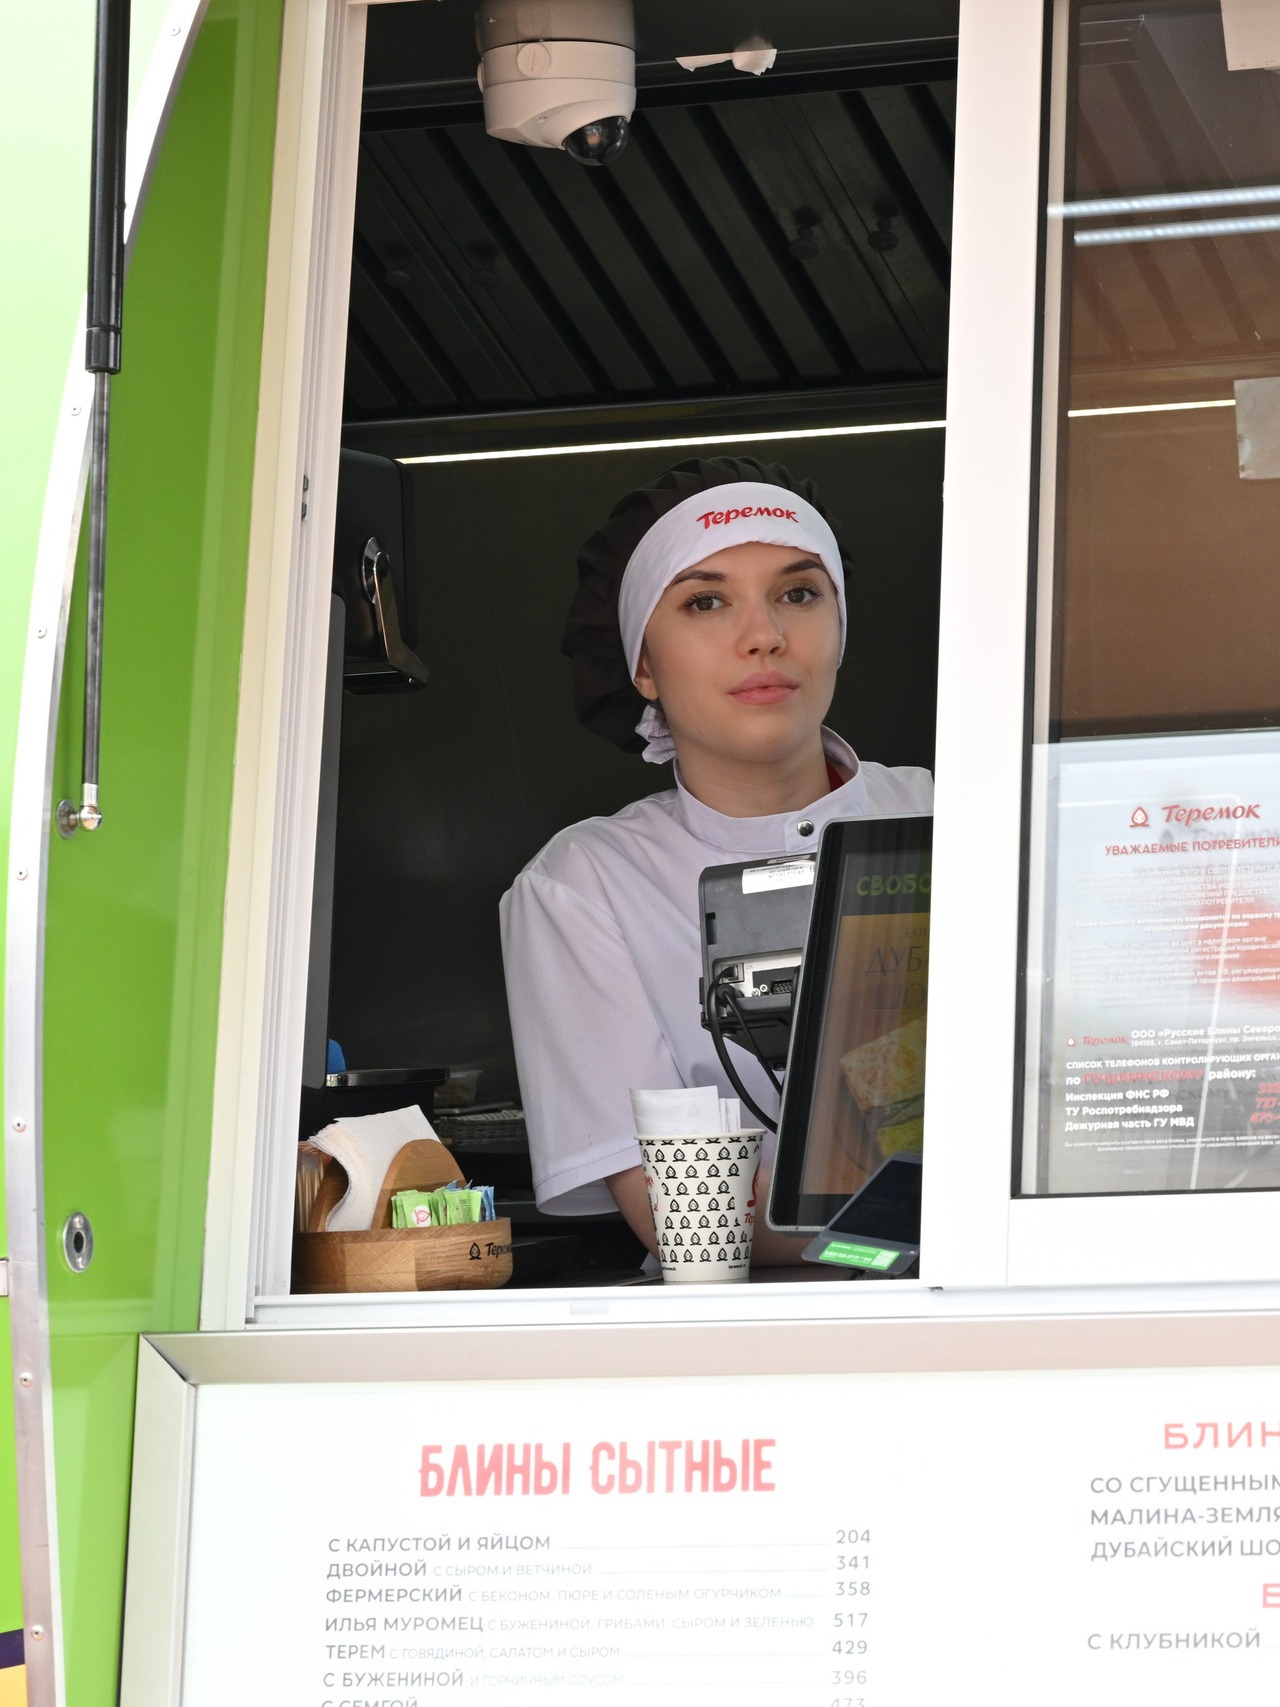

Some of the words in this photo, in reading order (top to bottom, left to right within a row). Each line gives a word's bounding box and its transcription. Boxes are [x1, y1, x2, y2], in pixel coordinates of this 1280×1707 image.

[696, 507, 799, 529] Теремок
[1161, 803, 1261, 827] Теремок
[1105, 839, 1188, 856] УВАЖАЕМЫЕ
[905, 927, 930, 938] БЛИ
[864, 946, 928, 977] ДУБ
[1082, 1036, 1128, 1047] Теремок
[1131, 1029, 1155, 1039] ООО
[1158, 1027, 1205, 1038] «Русские
[1066, 1059, 1103, 1069] СПИСОК
[1105, 1057, 1160, 1068] ТЕЛЕФОНОВ
[1162, 1053, 1252, 1066] КОНТРОЛИРУЮЩИХ
[1065, 1076, 1081, 1086] по
[1083, 1070, 1205, 1084] ПУШКИНСКОМУ
[1209, 1068, 1257, 1081] району:
[1065, 1091, 1123, 1102] Инспекция
[1126, 1088, 1150, 1099] ФНС
[1153, 1088, 1170, 1099] РФ
[1066, 1107, 1080, 1117] ТУ
[1082, 1103, 1183, 1117] Роспотребнадзора
[1064, 1120, 1120, 1132] Дежурная
[1121, 1119, 1151, 1129] часть
[1153, 1118, 1169, 1129] ГУ
[1170, 1116, 1195, 1128] МВД
[418, 1442, 571, 1497] БЛИНЫ
[589, 1438, 776, 1495] СЫТНЫЕ
[1090, 1477, 1122, 1494] СО
[328, 1539, 340, 1552] С
[347, 1534, 451, 1552] КАПУСТОЙ
[458, 1537, 470, 1550] И
[477, 1533, 550, 1552] ЯЙЦОМ
[837, 1529, 871, 1543] 204
[1091, 1536, 1232, 1562] ДУБАЙСКИЙ
[326, 1559, 426, 1580] ДВОЙНОЙ
[433, 1566, 443, 1576] С
[445, 1565, 498, 1576] СЫРОМ
[502, 1565, 512, 1575] И
[516, 1562, 592, 1575] ВЕТЧИНОЙ
[837, 1555, 868, 1570] 341
[326, 1584, 462, 1603] ФЕРМЕРСКИЙ
[468, 1591, 477, 1602] С
[481, 1591, 554, 1603] БЕКОНОМ,
[558, 1590, 598, 1601] ПЮРЕ
[603, 1590, 612, 1600] И
[616, 1588, 689, 1600] СОЛЕНЫМ
[694, 1587, 781, 1599] ОГУРЧИКОМ
[836, 1581, 870, 1596] 358
[325, 1617, 376, 1631] ИЛЬЯ
[384, 1617, 483, 1632] МУРОМЕЦ
[487, 1620, 497, 1630] С
[500, 1616, 594, 1631] БУЖЕНИНОЙ,
[597, 1617, 669, 1629] ГРИБАМИ,
[672, 1618, 726, 1629] СЫРОМ
[731, 1617, 740, 1627] И
[744, 1616, 814, 1628] ЗЕЛЕНЬЮ
[834, 1613, 868, 1627] 517
[1088, 1634, 1101, 1650] С
[1110, 1628, 1260, 1649] КЛУБНИКОЙ
[326, 1645, 385, 1659] ТЕРЕМ
[389, 1648, 399, 1659] С
[402, 1646, 487, 1661] ГОВЯДИНОЙ,
[490, 1647, 553, 1659] САЛАТОМ
[557, 1647, 566, 1658] И
[570, 1646, 620, 1658] СЫРОМ
[832, 1640, 867, 1654] 429
[323, 1673, 335, 1687] С
[343, 1668, 463, 1687] БУЖЕНИНОЙ
[470, 1676, 479, 1686] И
[482, 1675, 564, 1686] ГОРЧИЧНЫМ
[568, 1674, 624, 1685] СОУСОМ
[833, 1671, 866, 1684] 396
